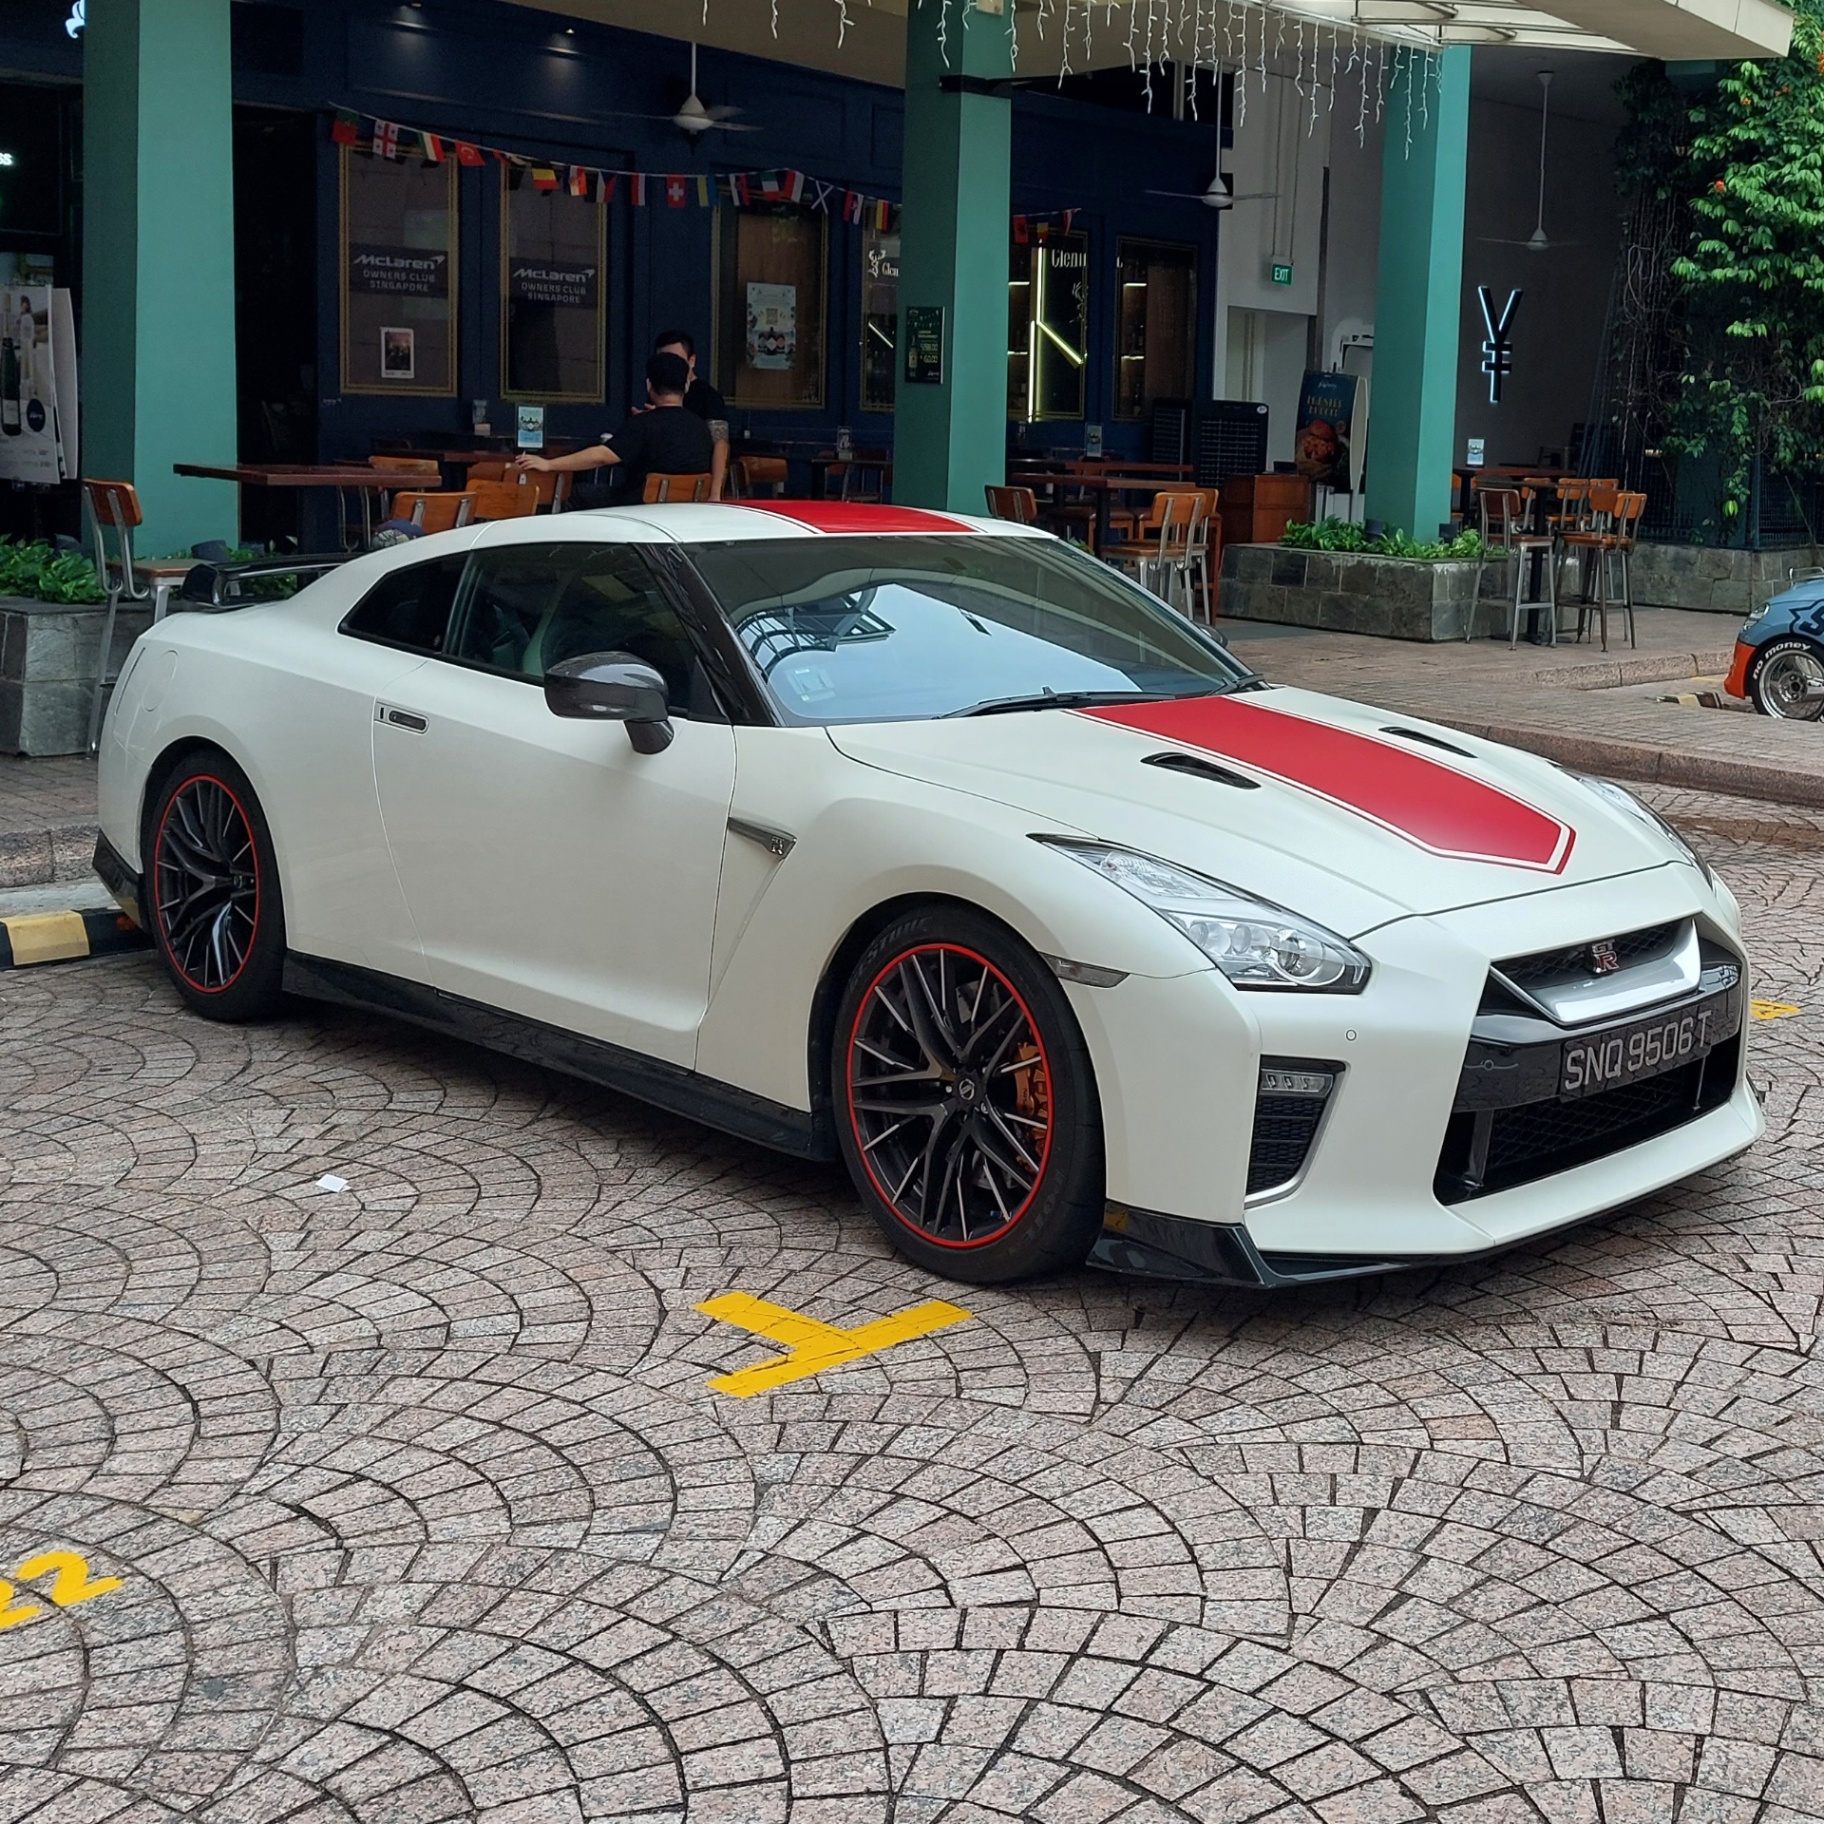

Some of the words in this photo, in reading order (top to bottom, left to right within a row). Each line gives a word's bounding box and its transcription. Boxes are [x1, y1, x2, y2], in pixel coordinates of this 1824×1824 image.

[353, 254, 436, 270] McLaren
[363, 269, 406, 281] OWNERS
[409, 273, 435, 283] CLUB
[513, 268, 586, 283] McLaren
[1274, 267, 1289, 281] EXIT
[369, 281, 428, 292] SINGAPORE
[521, 282, 560, 293] OWNERS
[563, 285, 587, 295] CLUB
[527, 291, 580, 303] SINGAPORE
[1752, 659, 1764, 680] no
[1765, 641, 1811, 660] money
